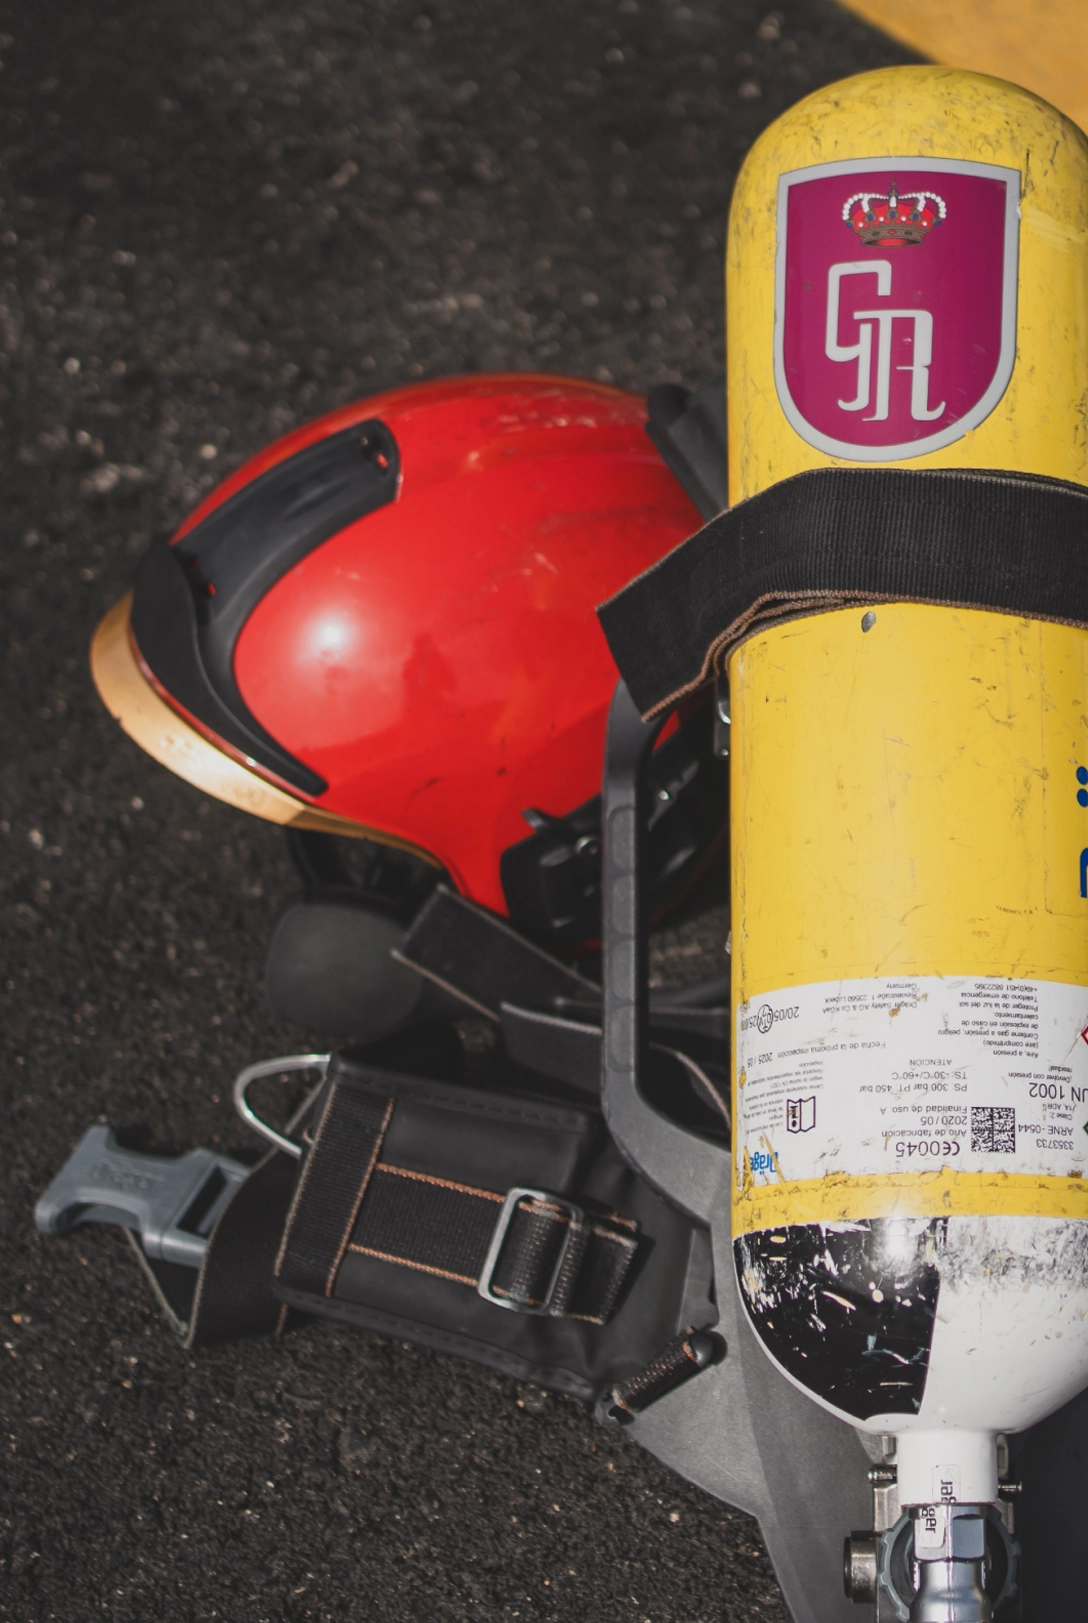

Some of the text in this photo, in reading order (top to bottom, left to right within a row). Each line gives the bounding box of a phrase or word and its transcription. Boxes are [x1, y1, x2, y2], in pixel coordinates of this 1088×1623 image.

[1012, 1003, 1038, 1012] Proteger
[861, 1041, 886, 1049] Fecha
[859, 1085, 873, 1093] bar
[876, 1085, 892, 1093] 450
[914, 1083, 928, 1091] bar
[931, 1083, 948, 1091] 300
[1029, 1083, 1065, 1099] 1002
[912, 1106, 922, 1114] de
[926, 1106, 967, 1114] Finalidad
[941, 1116, 967, 1125] 2020
[1047, 1126, 1073, 1136] ARNE
[1036, 1139, 1074, 1150] 3353733
[750, 1152, 778, 1176] Dräge
